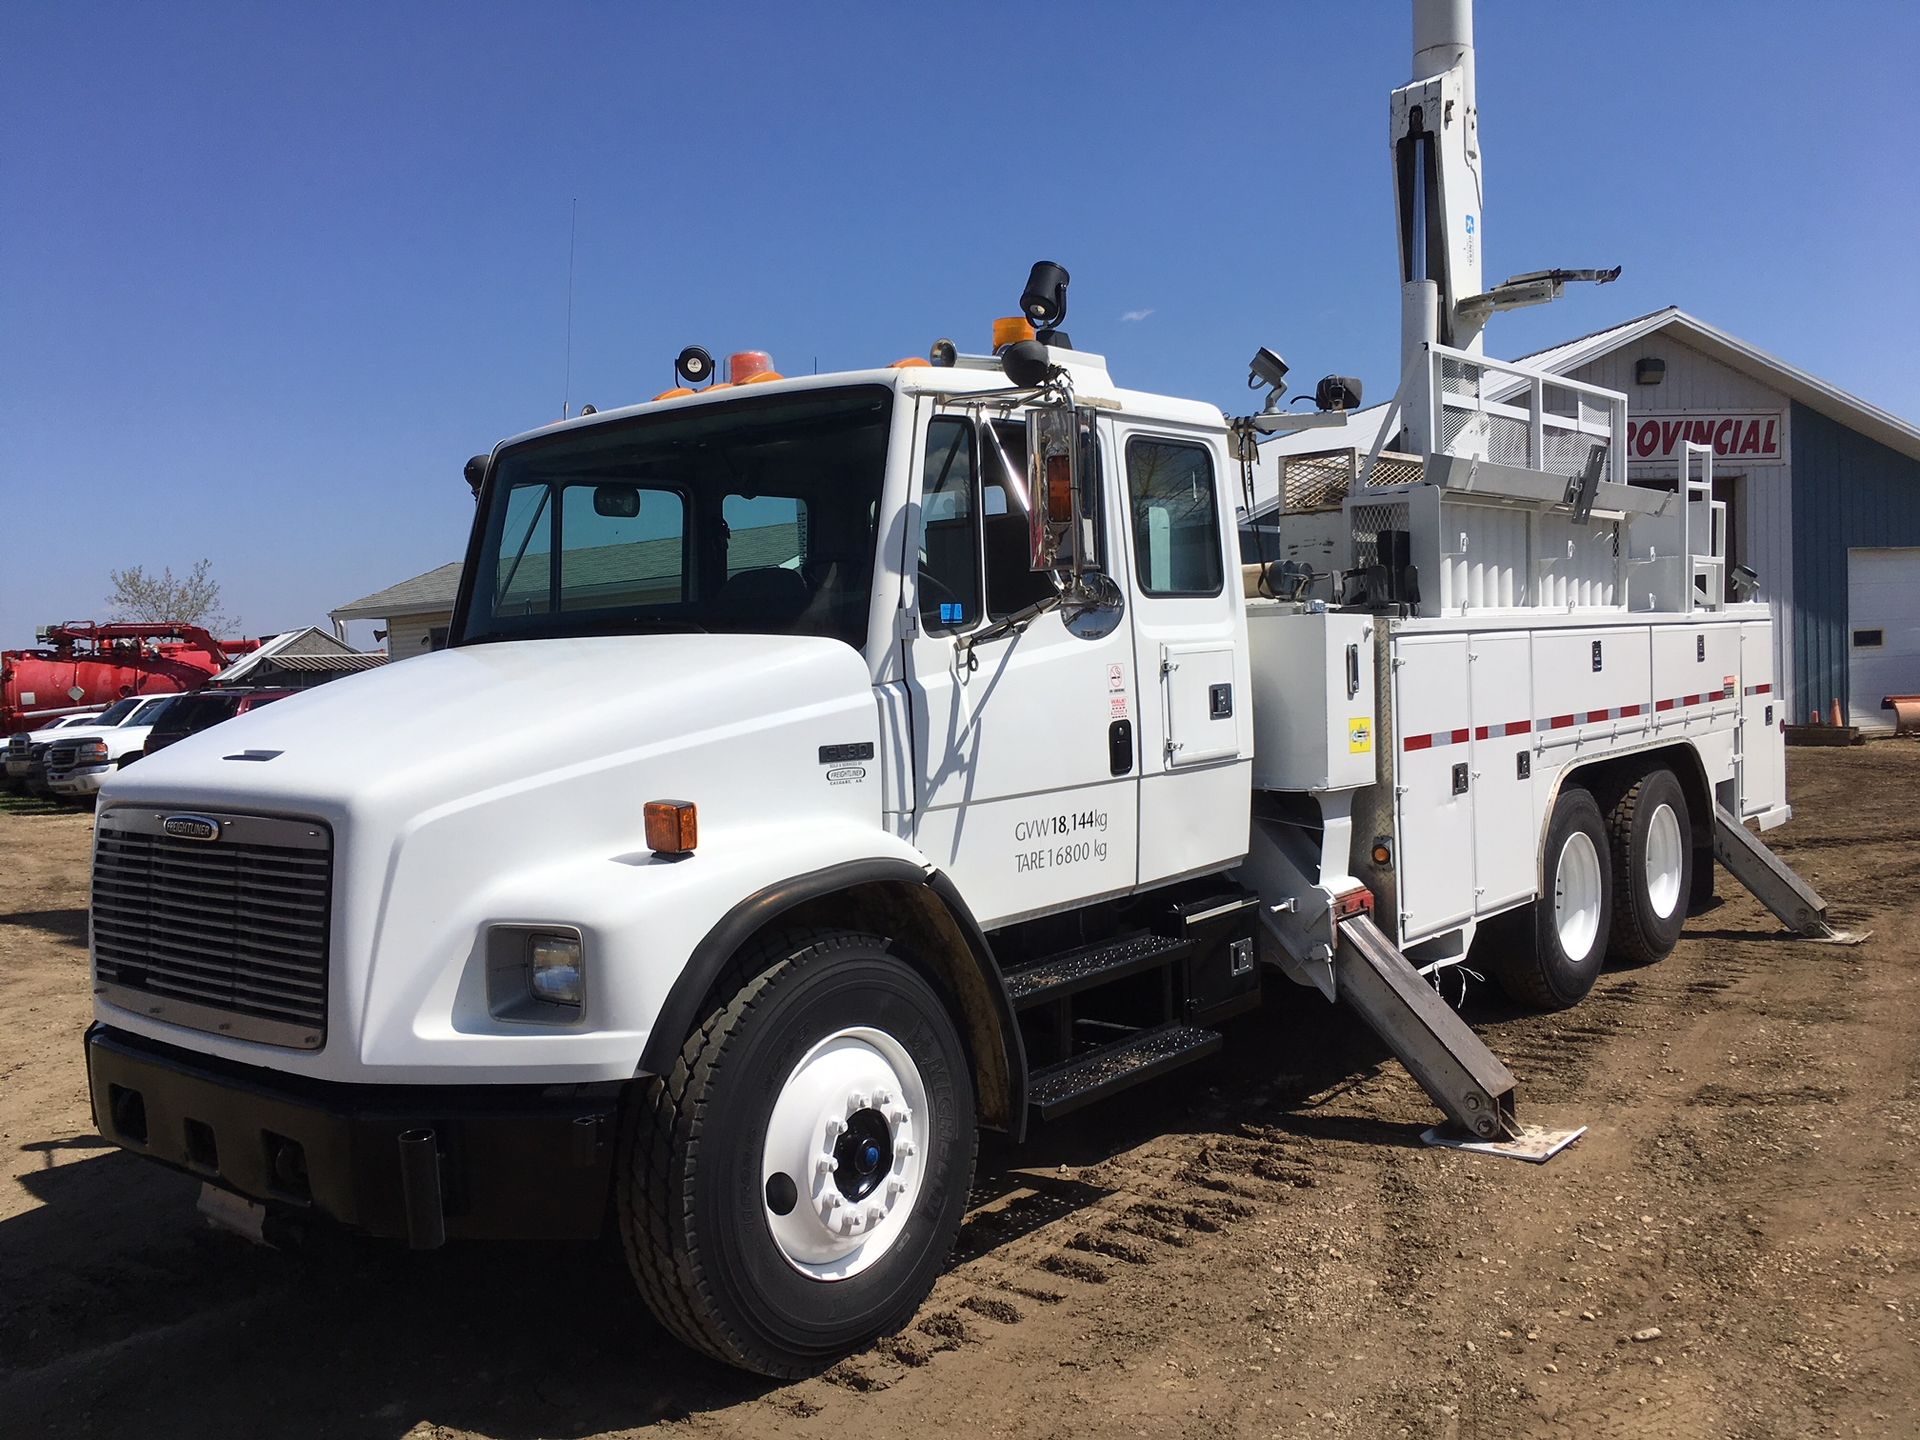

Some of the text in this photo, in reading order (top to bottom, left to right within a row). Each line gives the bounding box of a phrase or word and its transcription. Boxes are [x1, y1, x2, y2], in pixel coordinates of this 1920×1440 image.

[1627, 418, 1777, 458] ROVINCIAL
[166, 821, 210, 836] FREIGHTLINER
[1015, 818, 1050, 841] GVW
[1014, 850, 1045, 873] TARE
[1094, 839, 1107, 861] kg
